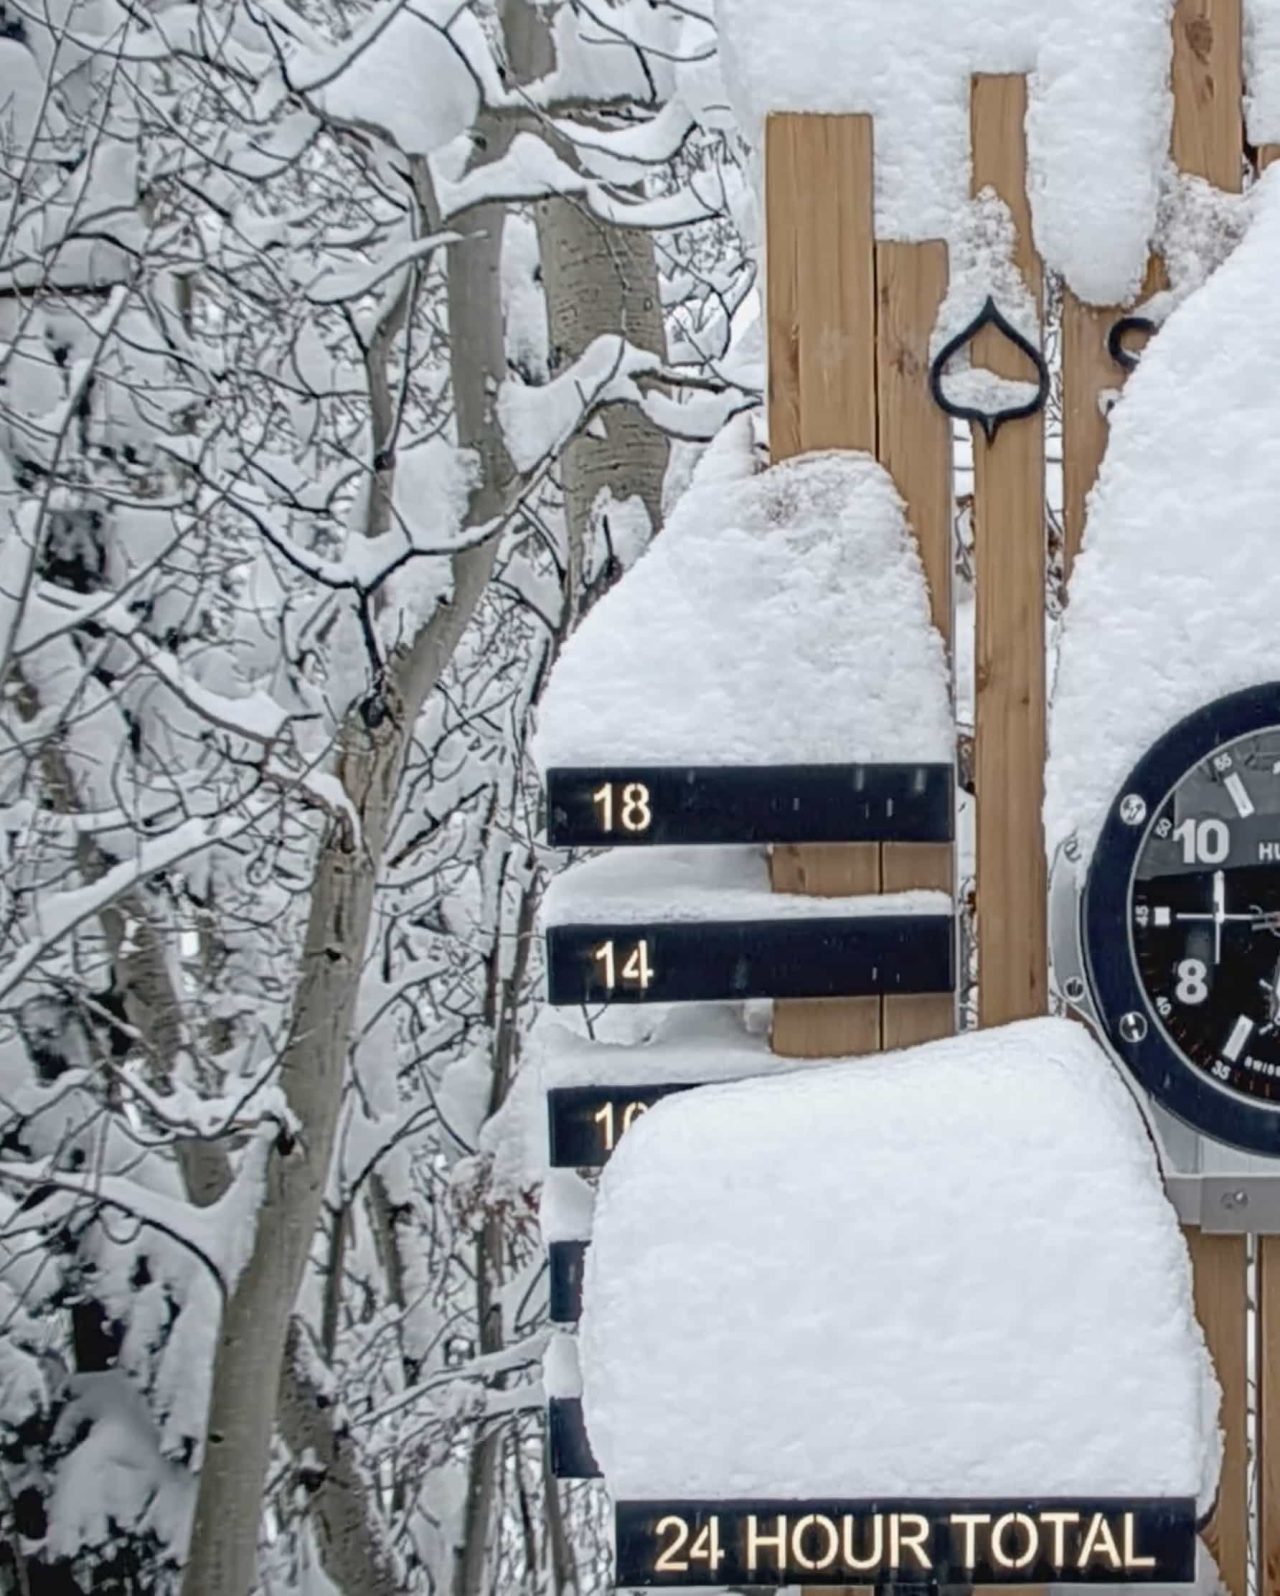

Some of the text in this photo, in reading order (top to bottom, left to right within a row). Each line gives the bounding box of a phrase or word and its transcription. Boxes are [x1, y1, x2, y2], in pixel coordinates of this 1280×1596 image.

[593, 783, 652, 831] 18
[1172, 818, 1230, 863] 10
[594, 939, 654, 989] 14
[1175, 958, 1208, 1005] 8
[1211, 1060, 1231, 1080] 35
[654, 1512, 1156, 1571] 24 HOUR TOTAL
